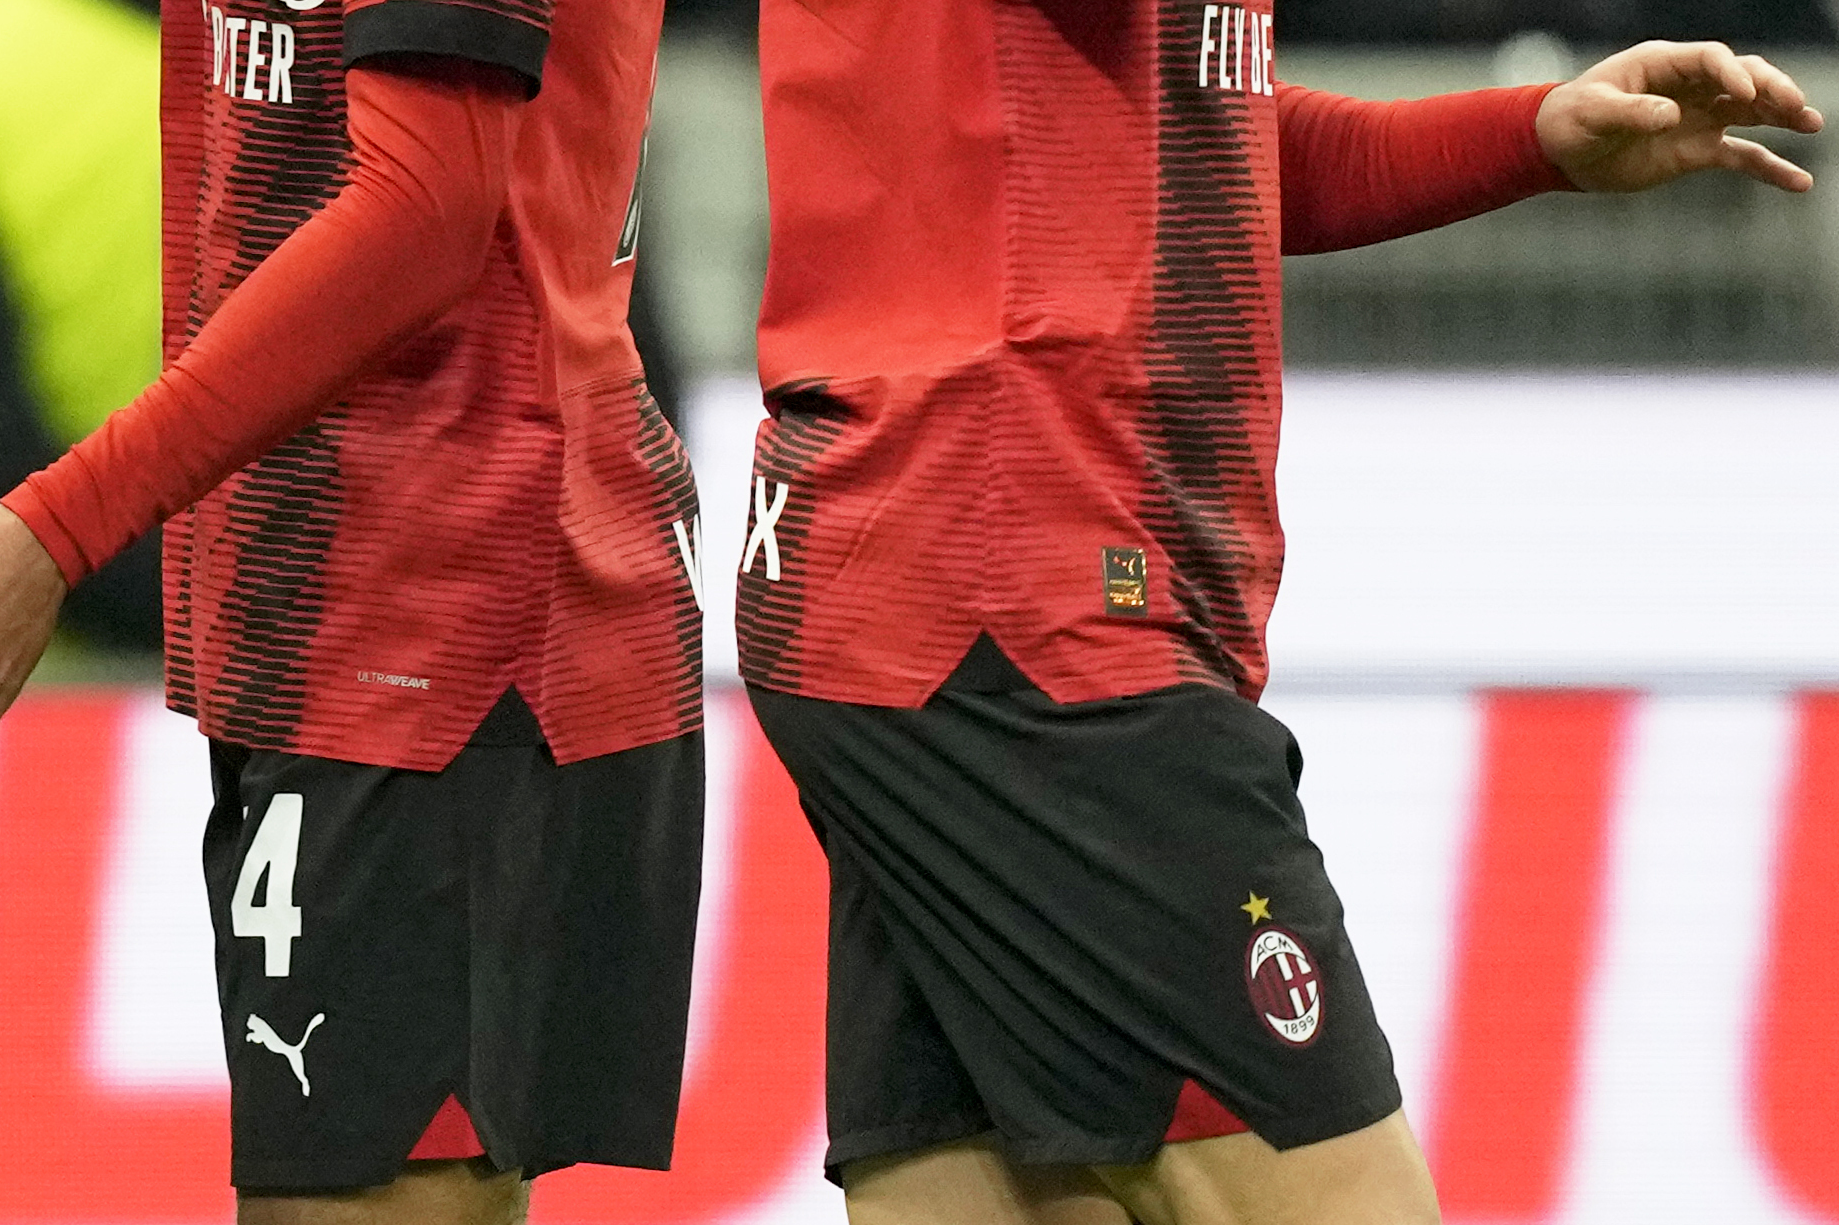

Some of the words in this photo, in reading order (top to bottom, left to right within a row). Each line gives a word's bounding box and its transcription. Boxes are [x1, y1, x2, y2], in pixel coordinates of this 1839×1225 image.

[1198, 4, 1246, 92] FLY
[357, 671, 432, 690] ULTRAWEAVE
[230, 792, 303, 977] 4
[1256, 936, 1294, 964] ACM
[1283, 1015, 1315, 1035] 1899
